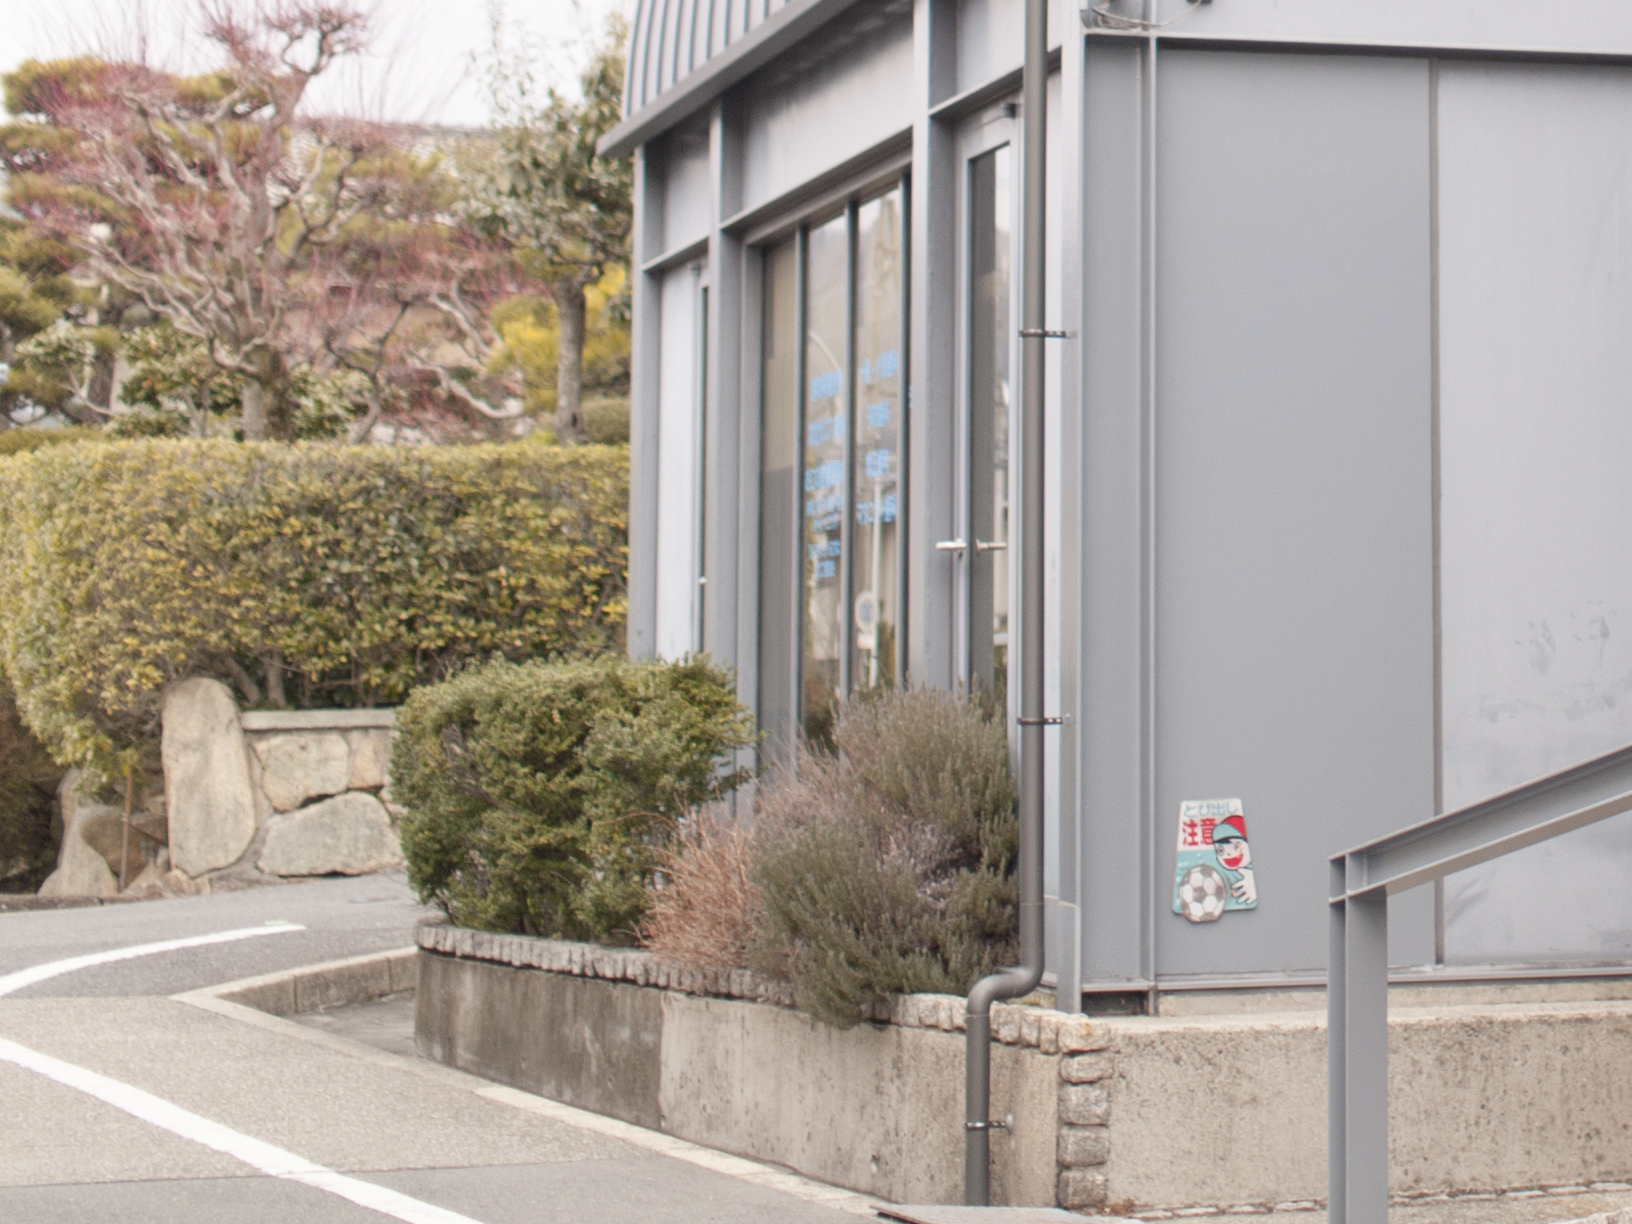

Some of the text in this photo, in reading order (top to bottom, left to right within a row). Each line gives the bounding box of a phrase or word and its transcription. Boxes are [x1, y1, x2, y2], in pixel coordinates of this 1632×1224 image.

[1183, 802, 1239, 818] とび出し
[1182, 818, 1216, 847] 注意
